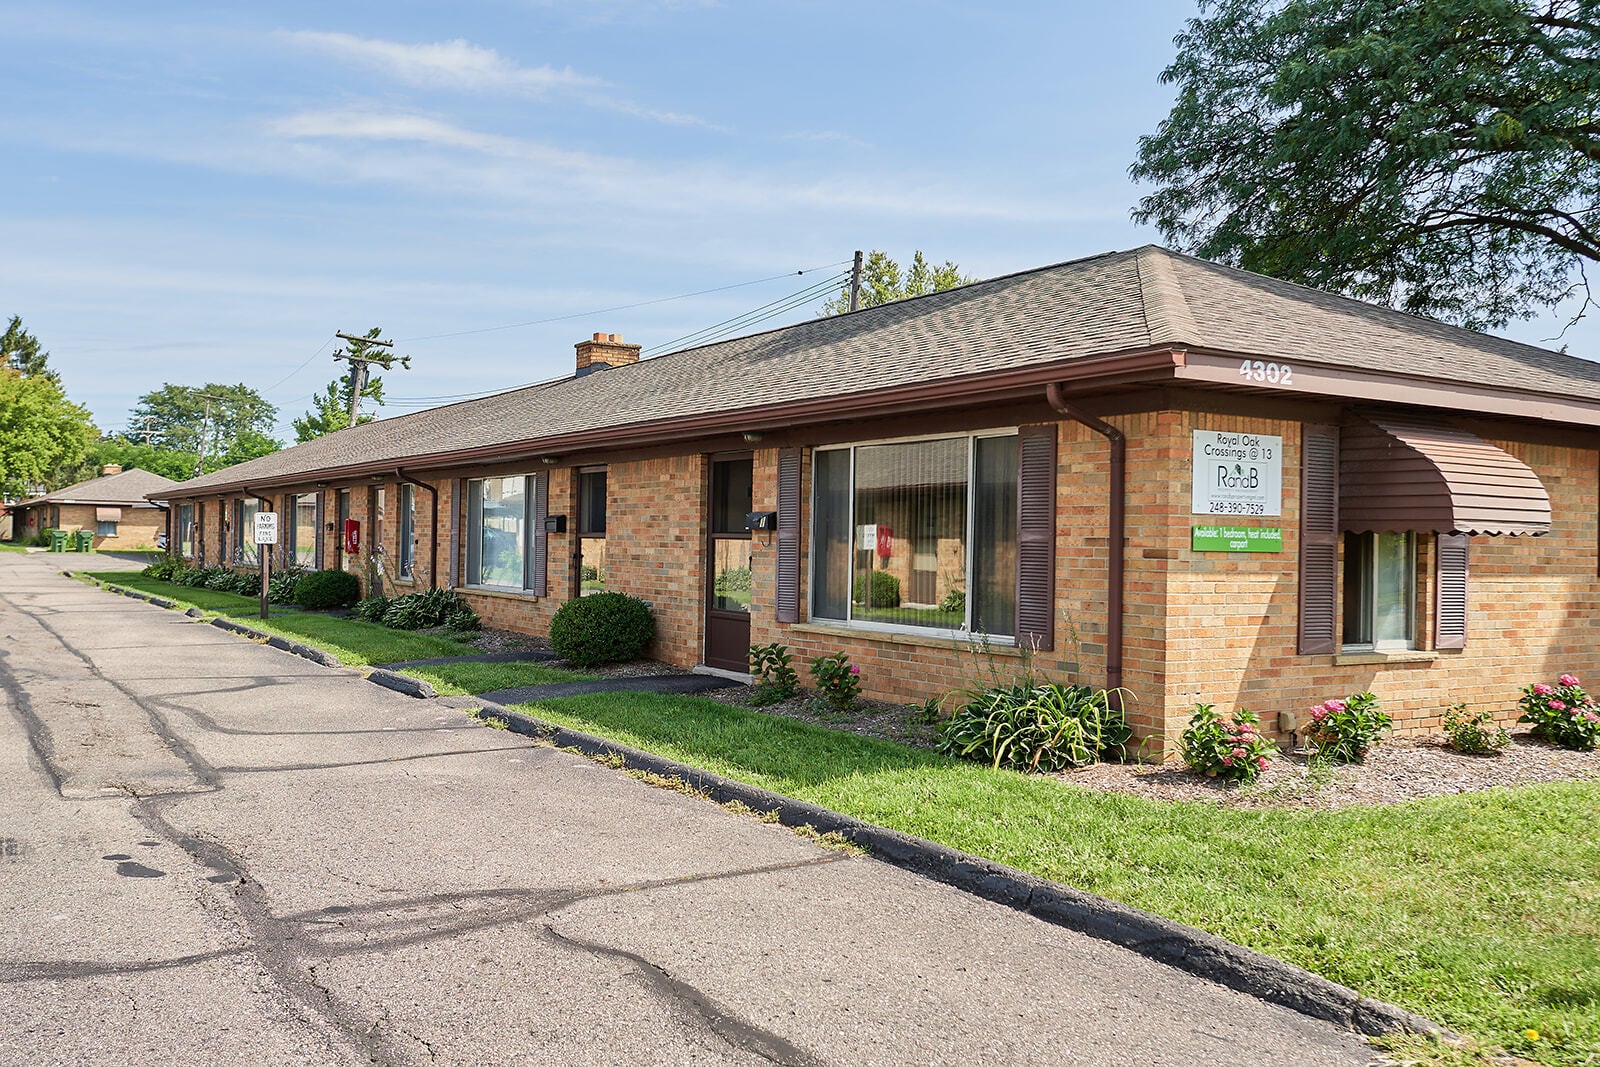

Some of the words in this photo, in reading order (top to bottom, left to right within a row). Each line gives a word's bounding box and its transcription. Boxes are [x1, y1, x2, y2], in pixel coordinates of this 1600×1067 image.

[1239, 359, 1293, 385] 4302
[1216, 433, 1240, 448] Royal
[1241, 435, 1260, 447] Oak
[1204, 444, 1246, 460] Crossings
[1249, 447, 1258, 460] @
[1262, 448, 1272, 460] 13
[1217, 465, 1259, 489] RandB
[1209, 502, 1264, 515] 248-390-7529
[1219, 527, 1223, 538] 1
[1247, 528, 1260, 539] heat
